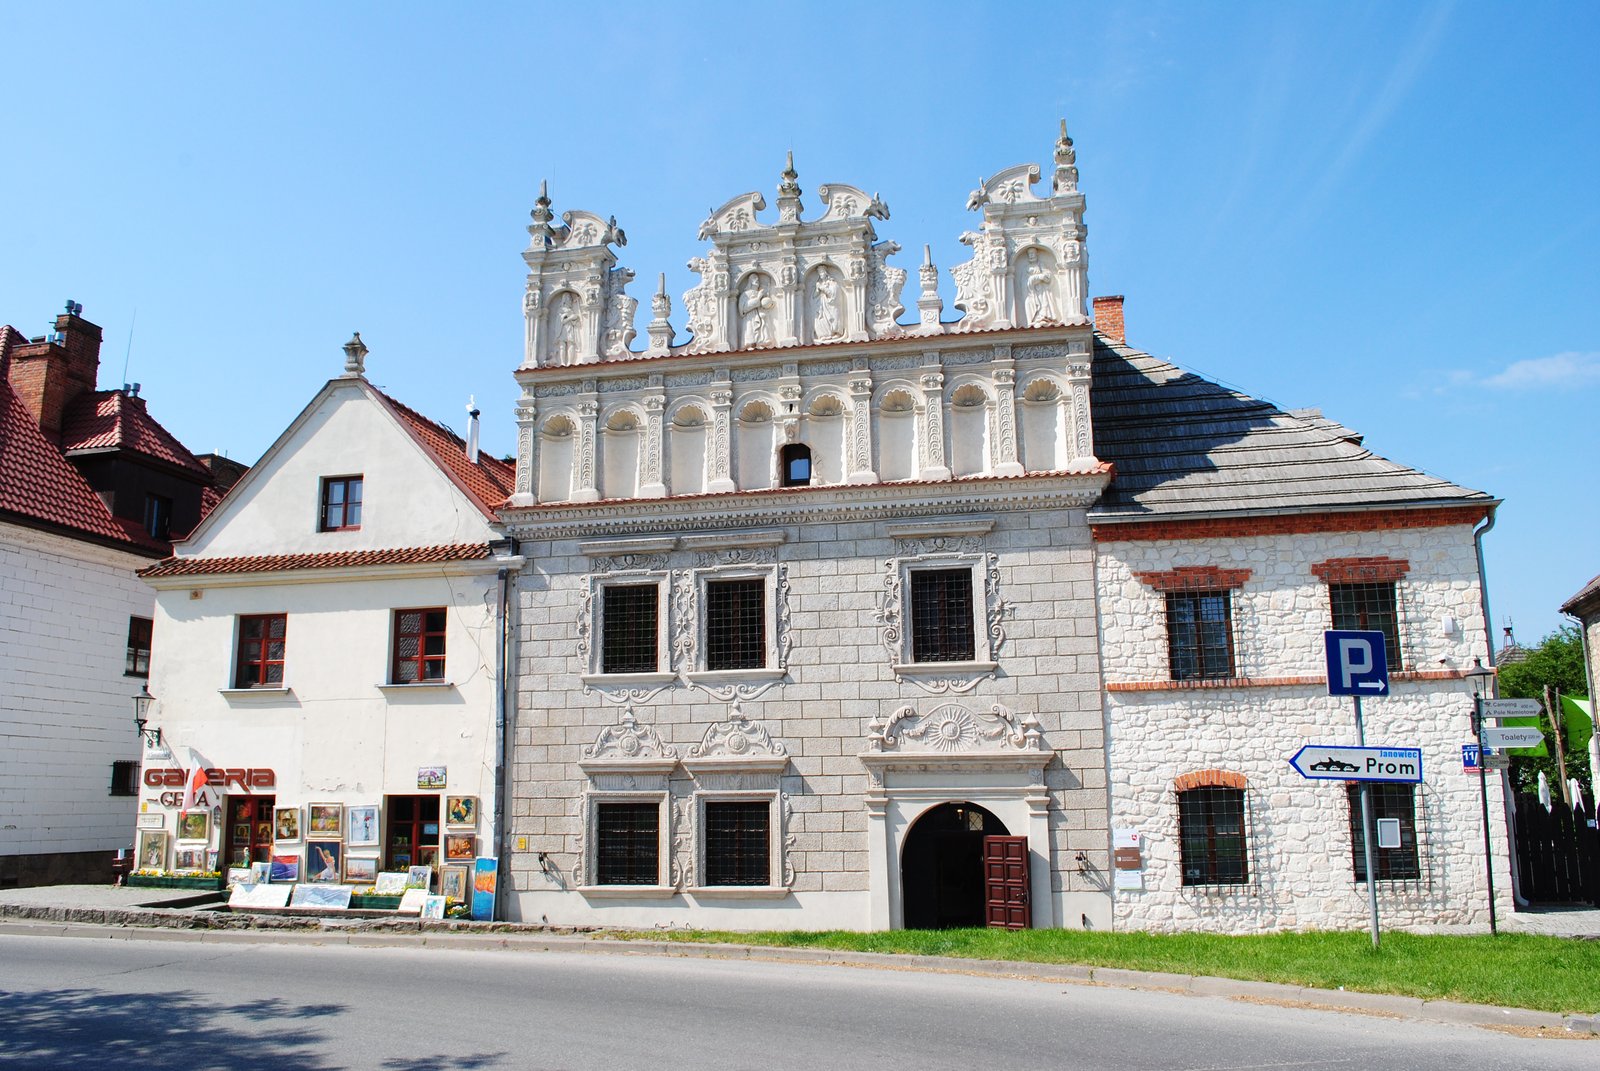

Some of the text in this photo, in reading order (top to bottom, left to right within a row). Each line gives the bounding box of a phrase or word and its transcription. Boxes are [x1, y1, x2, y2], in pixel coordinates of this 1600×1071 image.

[1339, 638, 1373, 688] P
[1500, 734, 1527, 742] Toalety
[1380, 750, 1418, 758] Janowiec
[1366, 757, 1415, 775] Prom
[160, 790, 210, 807] GEA
